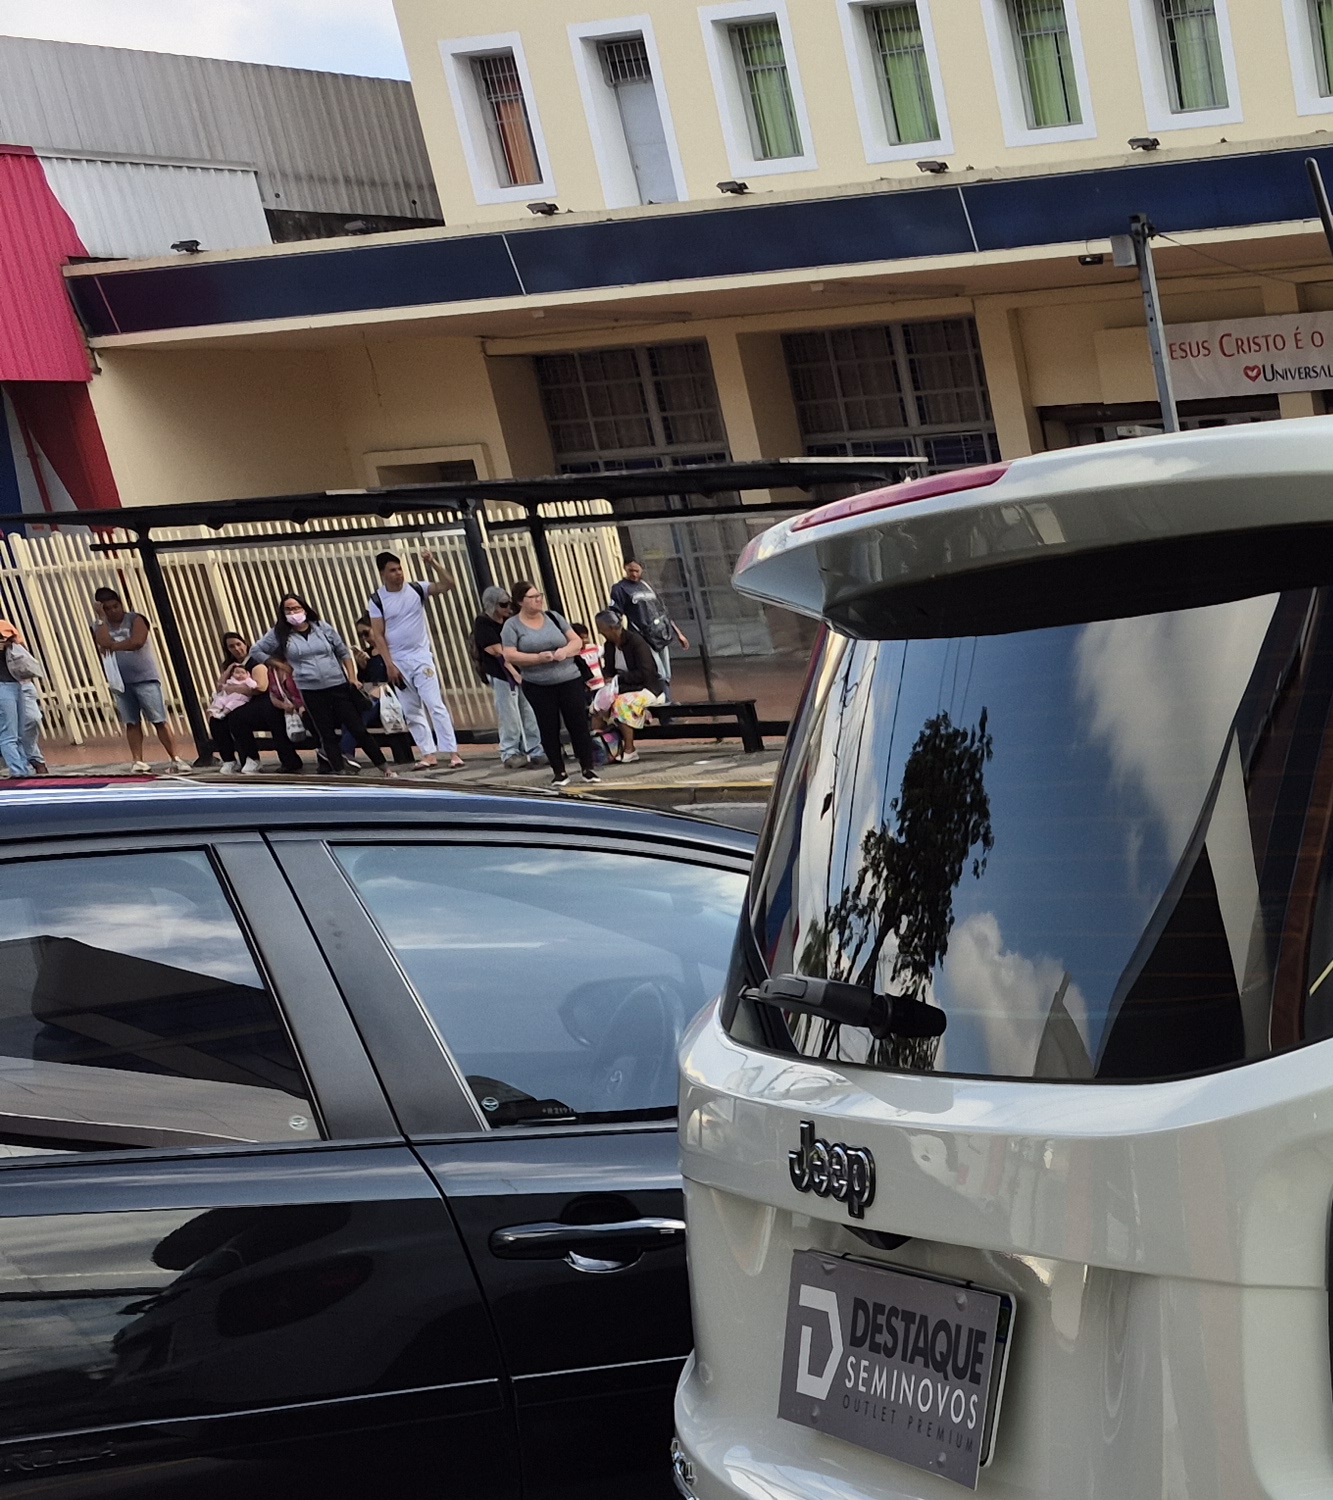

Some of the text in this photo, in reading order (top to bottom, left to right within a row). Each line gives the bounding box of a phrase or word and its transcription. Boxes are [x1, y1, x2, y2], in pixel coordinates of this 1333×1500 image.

[1168, 338, 1212, 361] ESUS
[1218, 332, 1287, 358] CRISTO
[1294, 327, 1305, 349] É
[789, 1119, 877, 1220] Jeep
[850, 1297, 987, 1385] DESTAQUE
[843, 1394, 973, 1452] OUTLET PREMIUM
[845, 1355, 978, 1430] SEMINOVOS
